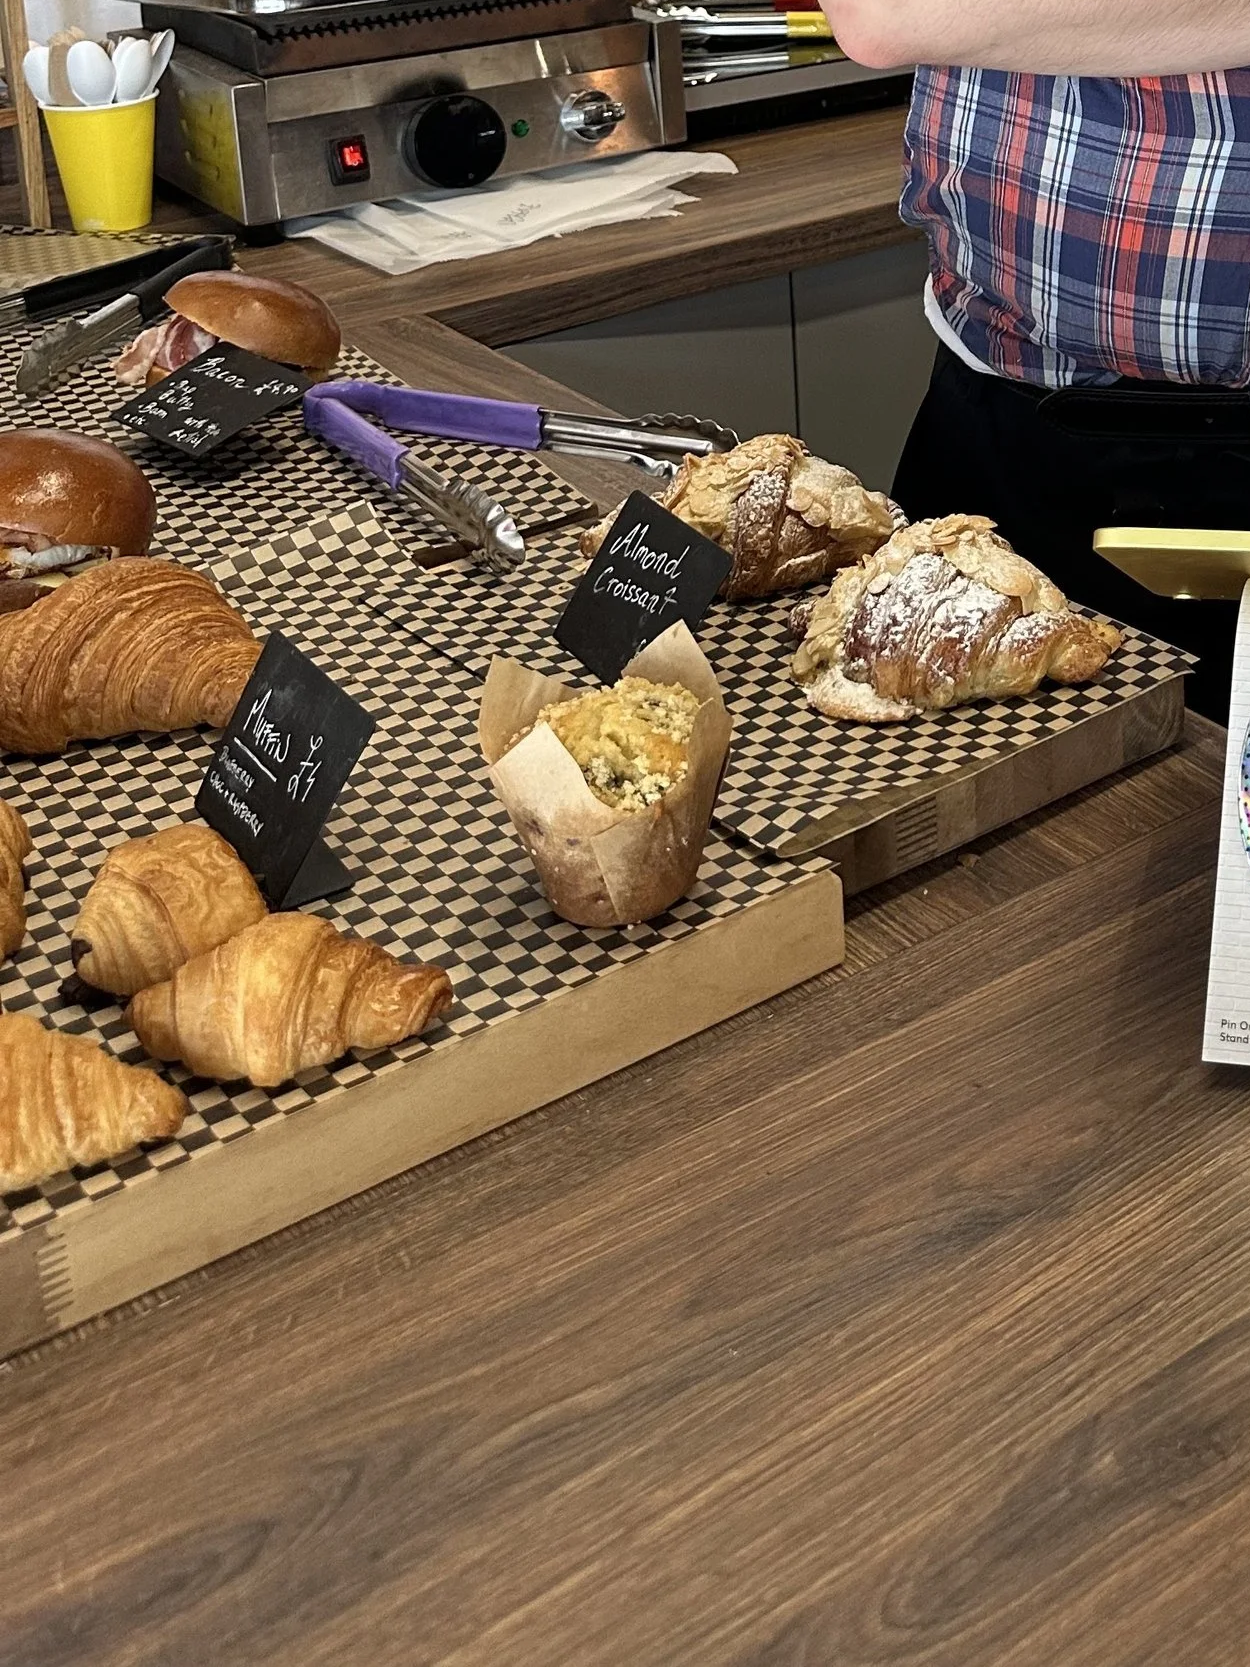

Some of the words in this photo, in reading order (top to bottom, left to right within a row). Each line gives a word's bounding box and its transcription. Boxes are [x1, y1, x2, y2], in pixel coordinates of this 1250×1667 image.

[191, 357, 249, 389] Bacon
[609, 522, 690, 580] Almond
[593, 566, 678, 615] Croissant
[1220, 1032, 1249, 1044] Stand
[1221, 1019, 1236, 1030] Pin
